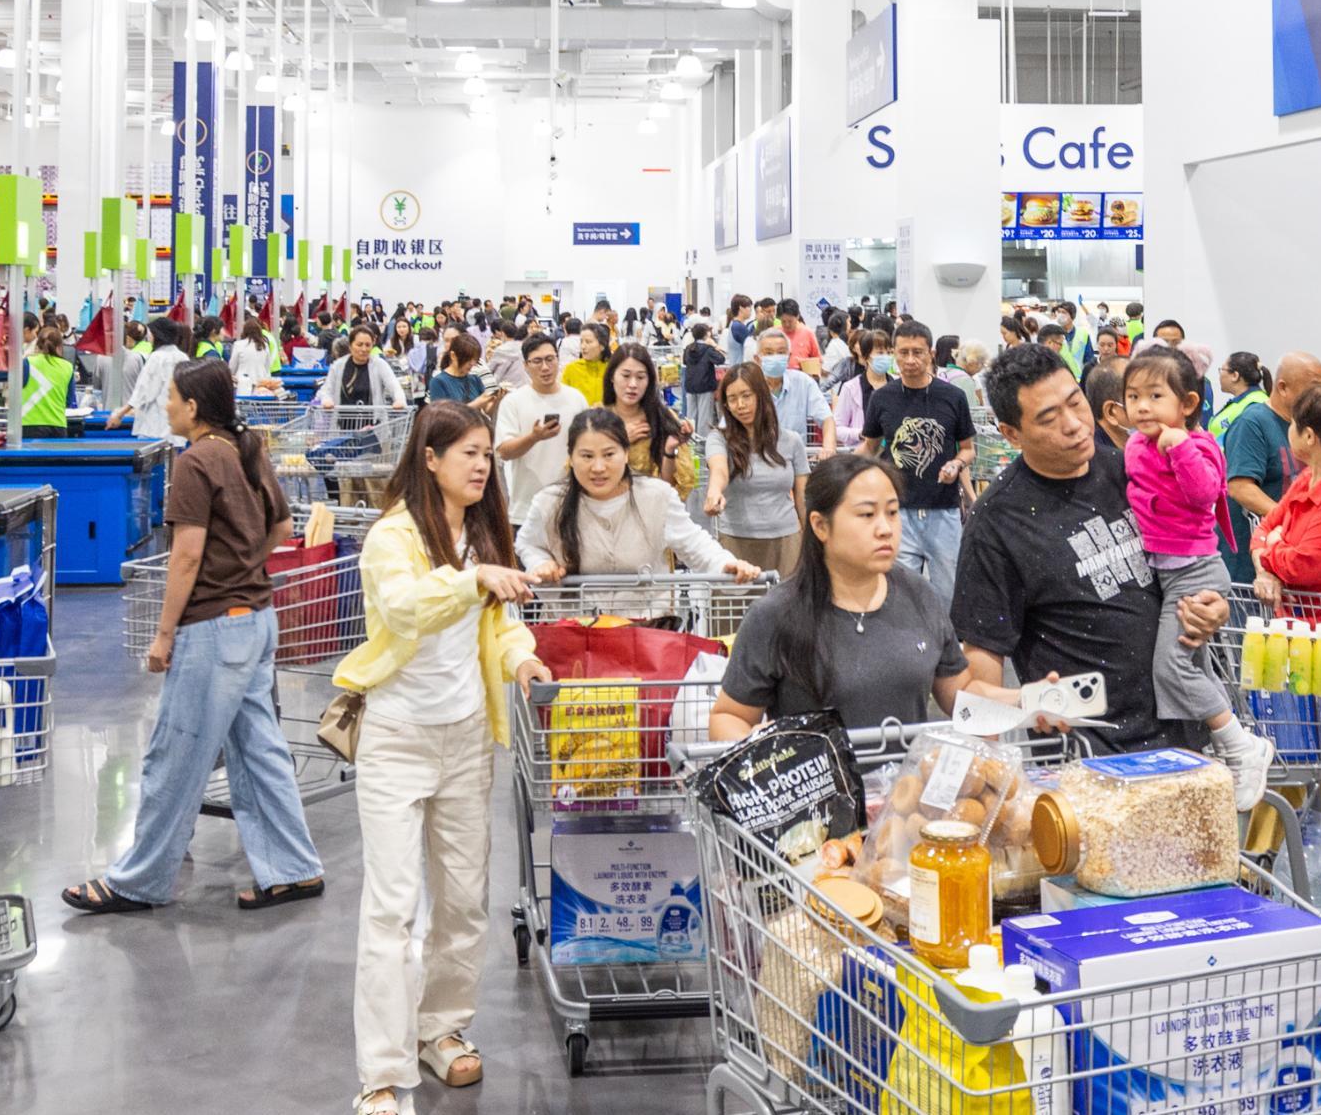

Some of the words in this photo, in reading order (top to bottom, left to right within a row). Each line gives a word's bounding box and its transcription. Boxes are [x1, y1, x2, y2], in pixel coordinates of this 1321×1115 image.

[1022, 125, 1134, 169] Cafe
[356, 238, 444, 256] 自助收银区
[356, 258, 380, 271] Self
[383, 258, 443, 271] Checkout
[795, 770, 834, 796] SAUSAGE
[610, 881, 652, 893] 多效酵素
[615, 894, 647, 905] 洗衣液
